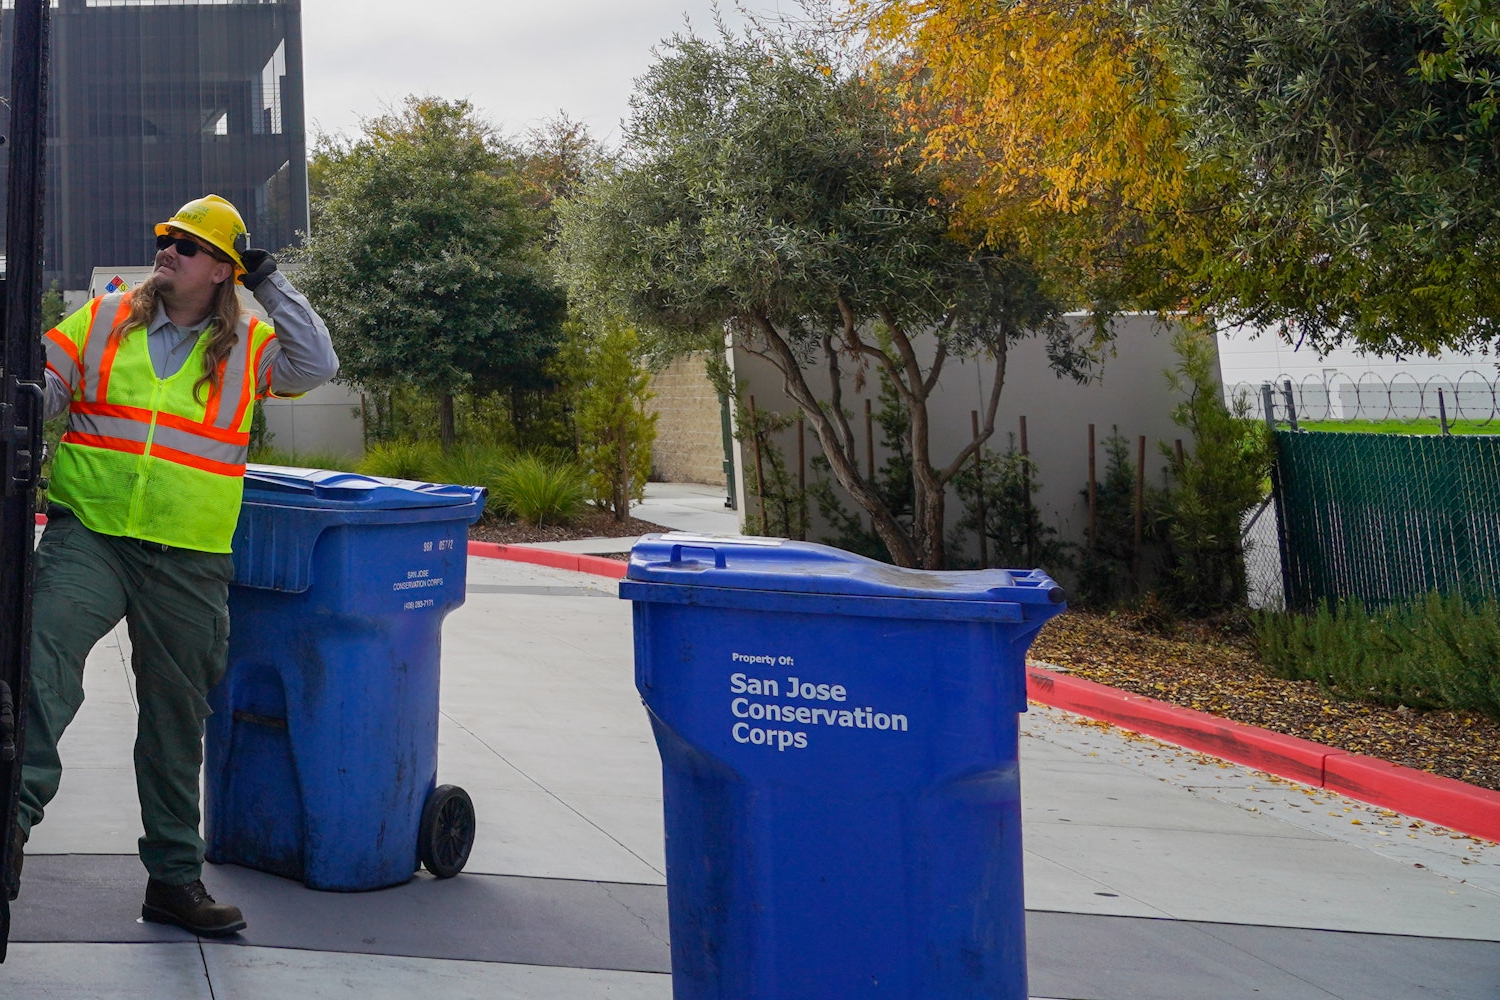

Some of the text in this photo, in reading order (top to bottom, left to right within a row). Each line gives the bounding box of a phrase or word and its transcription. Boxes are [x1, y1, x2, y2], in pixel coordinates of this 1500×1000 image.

[393, 578, 444, 590] CONSERVATION CORPS
[407, 569, 429, 579] SAN JOSE
[732, 652, 794, 667] Property Of:
[730, 672, 847, 702] San Jose
[731, 697, 908, 732] Conservation
[731, 721, 808, 752] Corps
